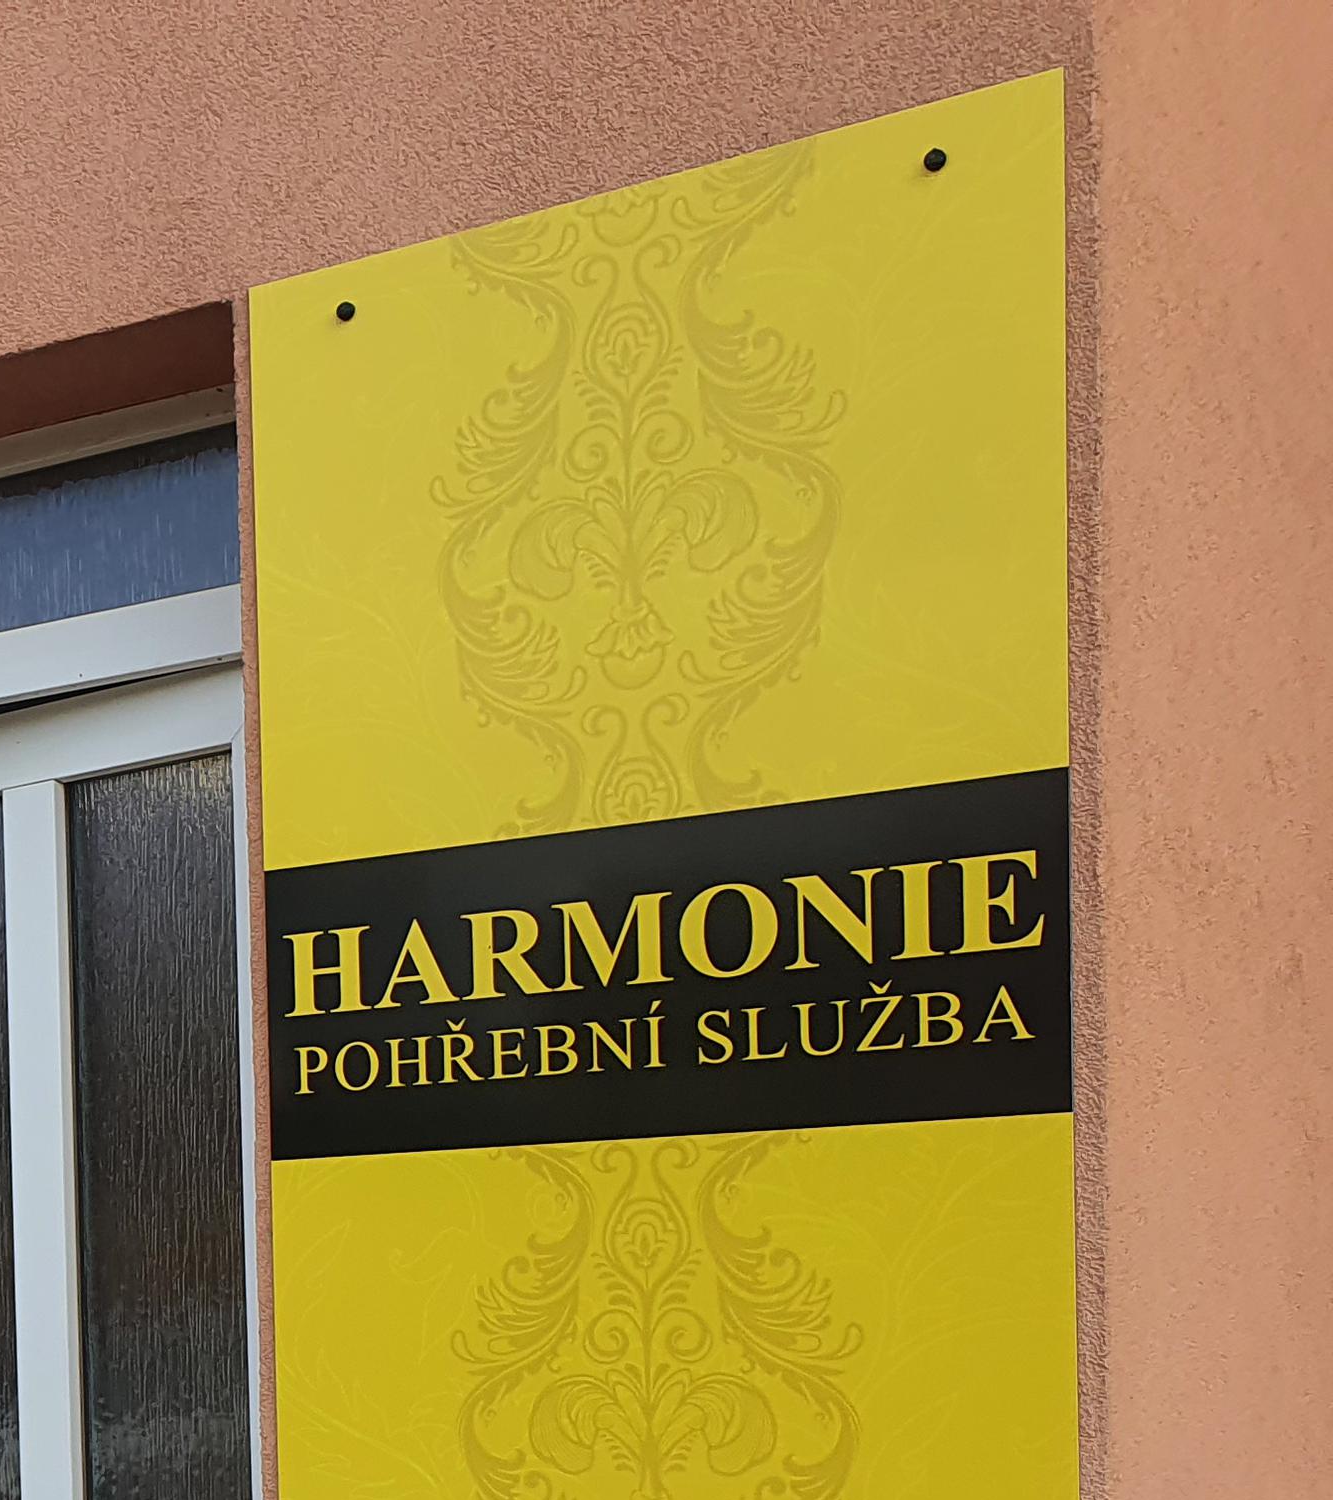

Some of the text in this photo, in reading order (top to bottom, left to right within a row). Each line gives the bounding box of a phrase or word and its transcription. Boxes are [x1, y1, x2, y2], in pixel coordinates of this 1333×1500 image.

[283, 850, 1044, 1017] HARMONIE
[295, 980, 1035, 1095] POHŘEBNÍ SLUŽBA
